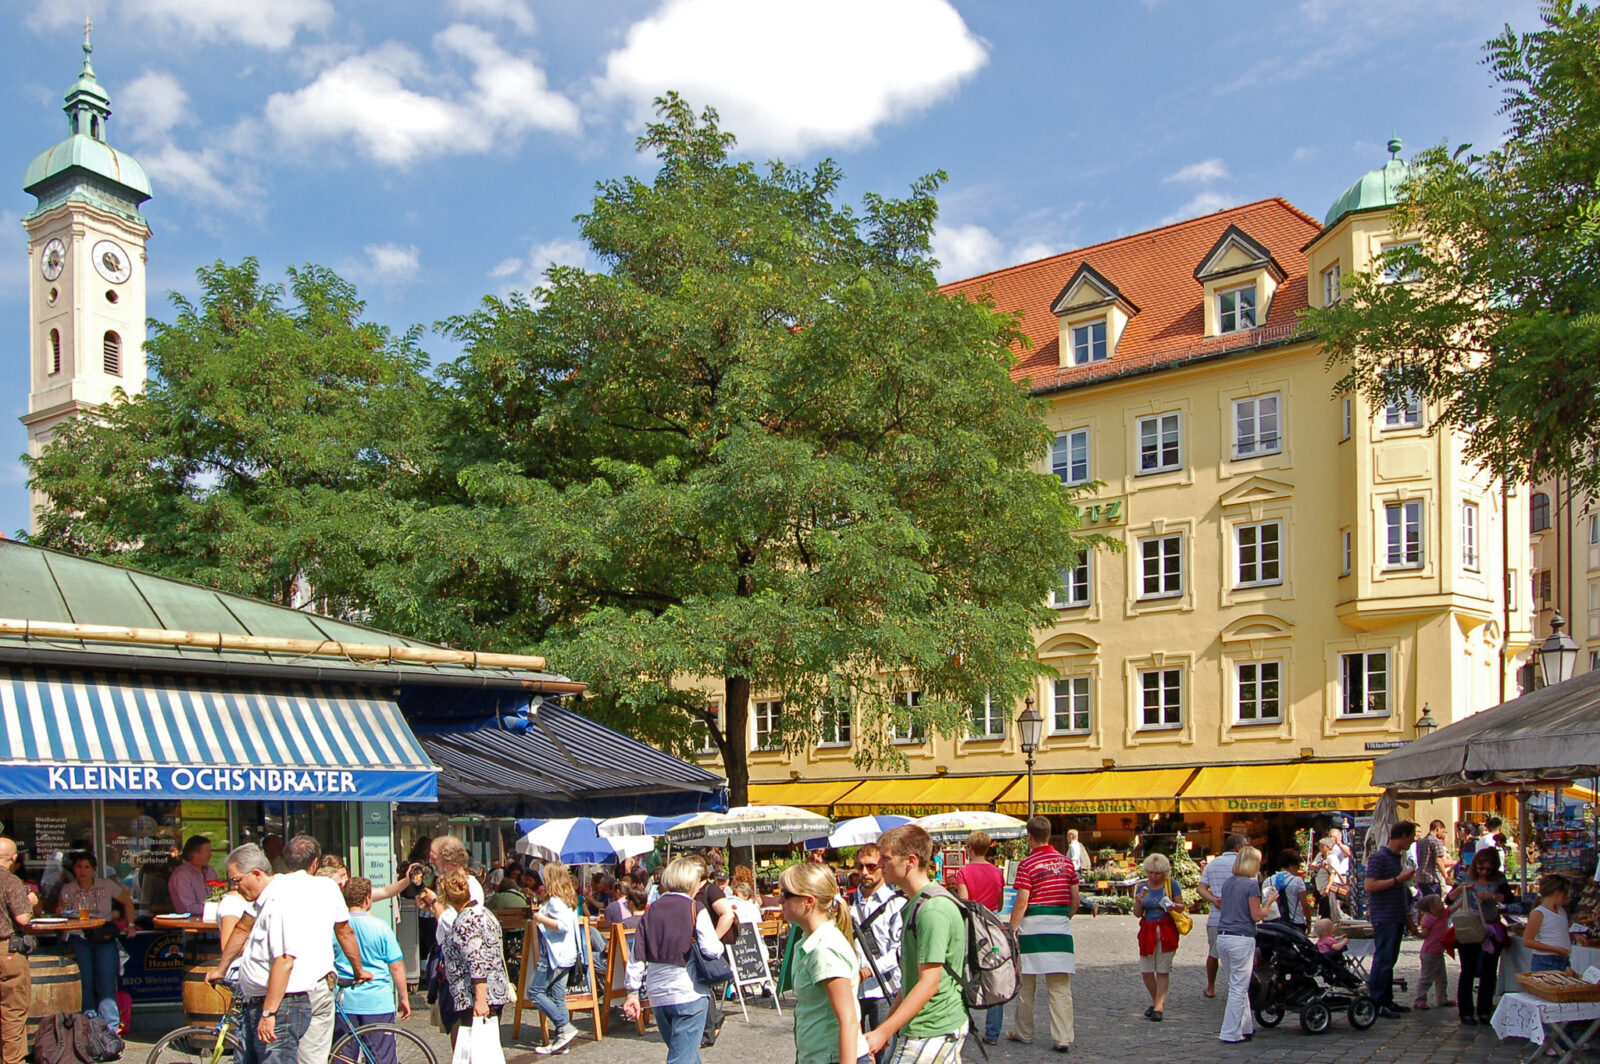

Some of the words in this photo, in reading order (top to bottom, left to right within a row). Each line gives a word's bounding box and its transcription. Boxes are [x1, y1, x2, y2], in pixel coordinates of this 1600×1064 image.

[48, 767, 162, 790] KLEINER
[1033, 802, 1136, 813] Pflanzenschutz
[1228, 799, 1284, 811] Dünger
[1300, 798, 1337, 809] Erde
[879, 806, 940, 816] Zoobedarf
[148, 958, 184, 969] Brauh
[122, 977, 142, 985] BIO
